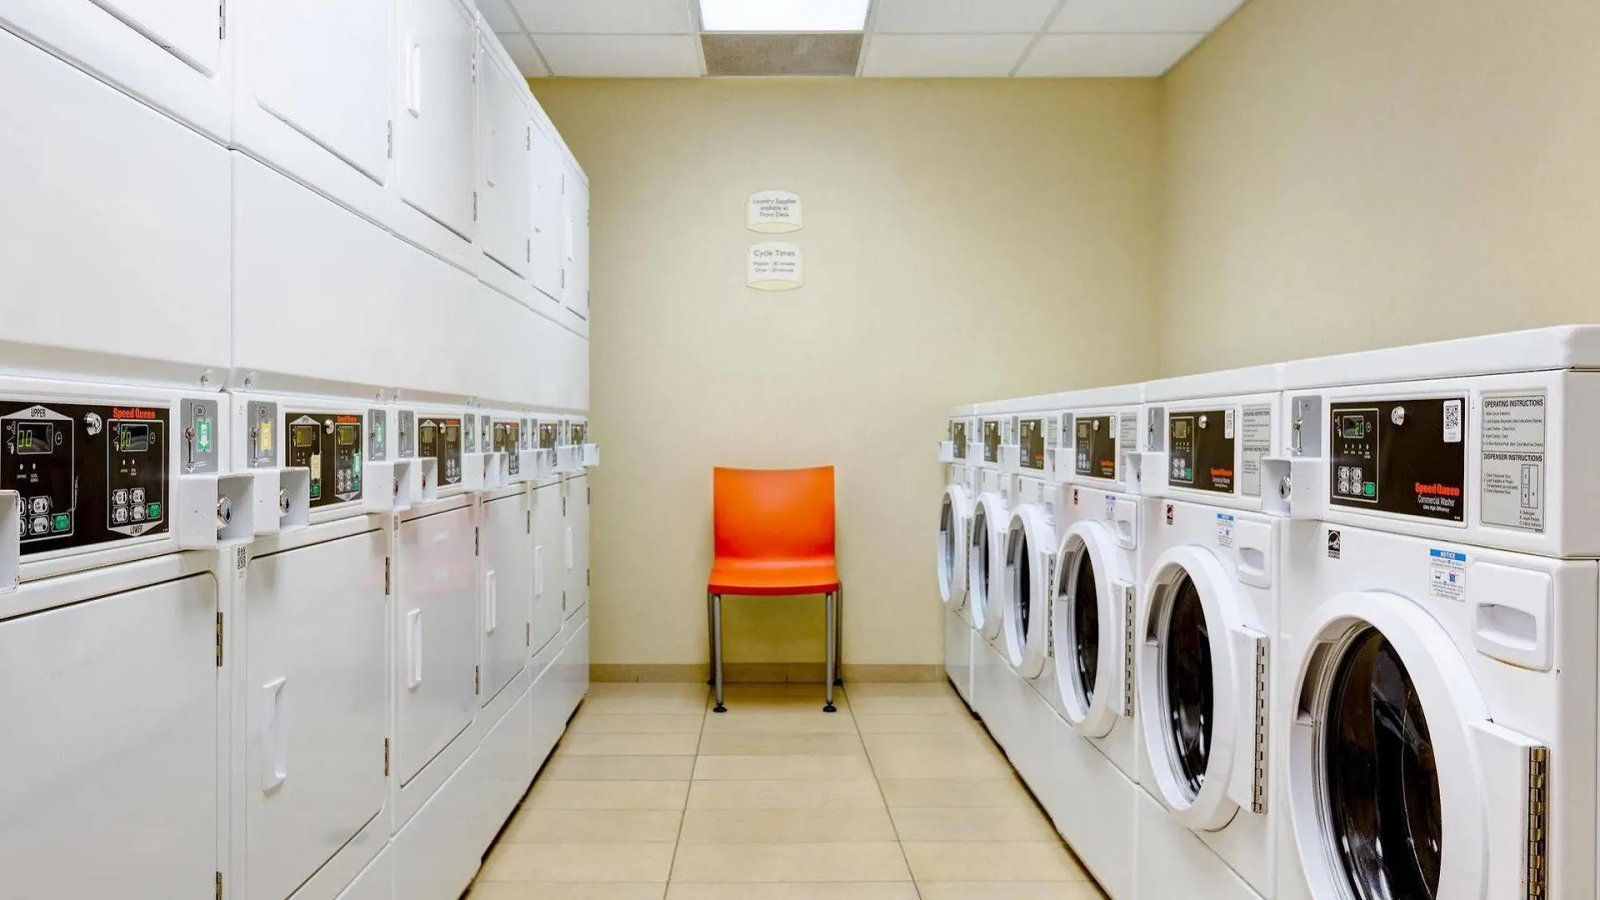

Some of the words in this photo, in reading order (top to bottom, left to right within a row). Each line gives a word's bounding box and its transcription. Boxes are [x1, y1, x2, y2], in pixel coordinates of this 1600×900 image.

[754, 250, 772, 258] Cycle
[1484, 400, 1509, 408] OPERATING
[1509, 399, 1543, 408] INSTRUCTIONS
[30, 408, 47, 418] UPPER
[112, 408, 135, 420] Speed
[135, 408, 156, 419] Queen
[1483, 452, 1508, 461] DISPENSER
[1508, 453, 1543, 463] INSTRUCTIONS
[1415, 482, 1437, 495] Speed
[1437, 483, 1460, 497] Queen
[1417, 495, 1440, 505] Commercial
[1440, 497, 1456, 507] Washer
[129, 524, 143, 535] LOWER
[1440, 551, 1456, 559] NOTICE
